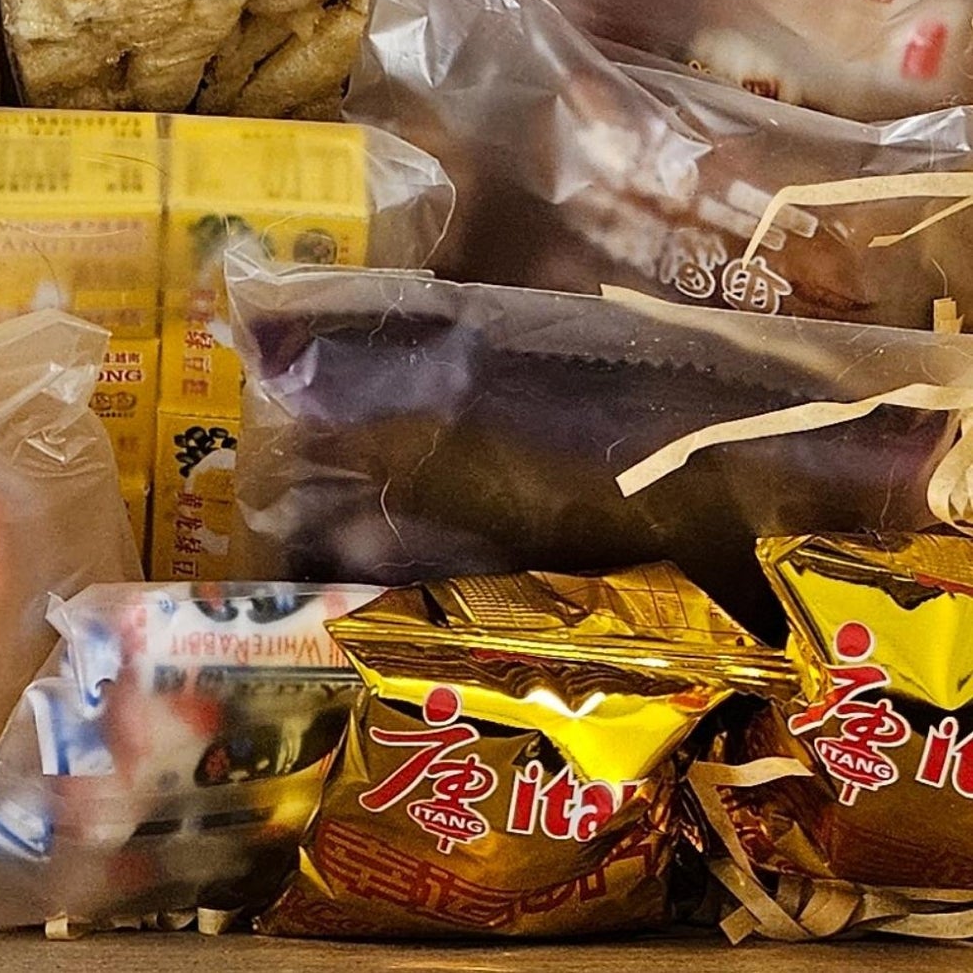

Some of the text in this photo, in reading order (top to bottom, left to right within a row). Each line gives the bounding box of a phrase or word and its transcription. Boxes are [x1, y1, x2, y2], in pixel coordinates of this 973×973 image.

[819, 742, 893, 779] ITANG
[507, 760, 641, 842] ita
[413, 805, 485, 835] ITANG
